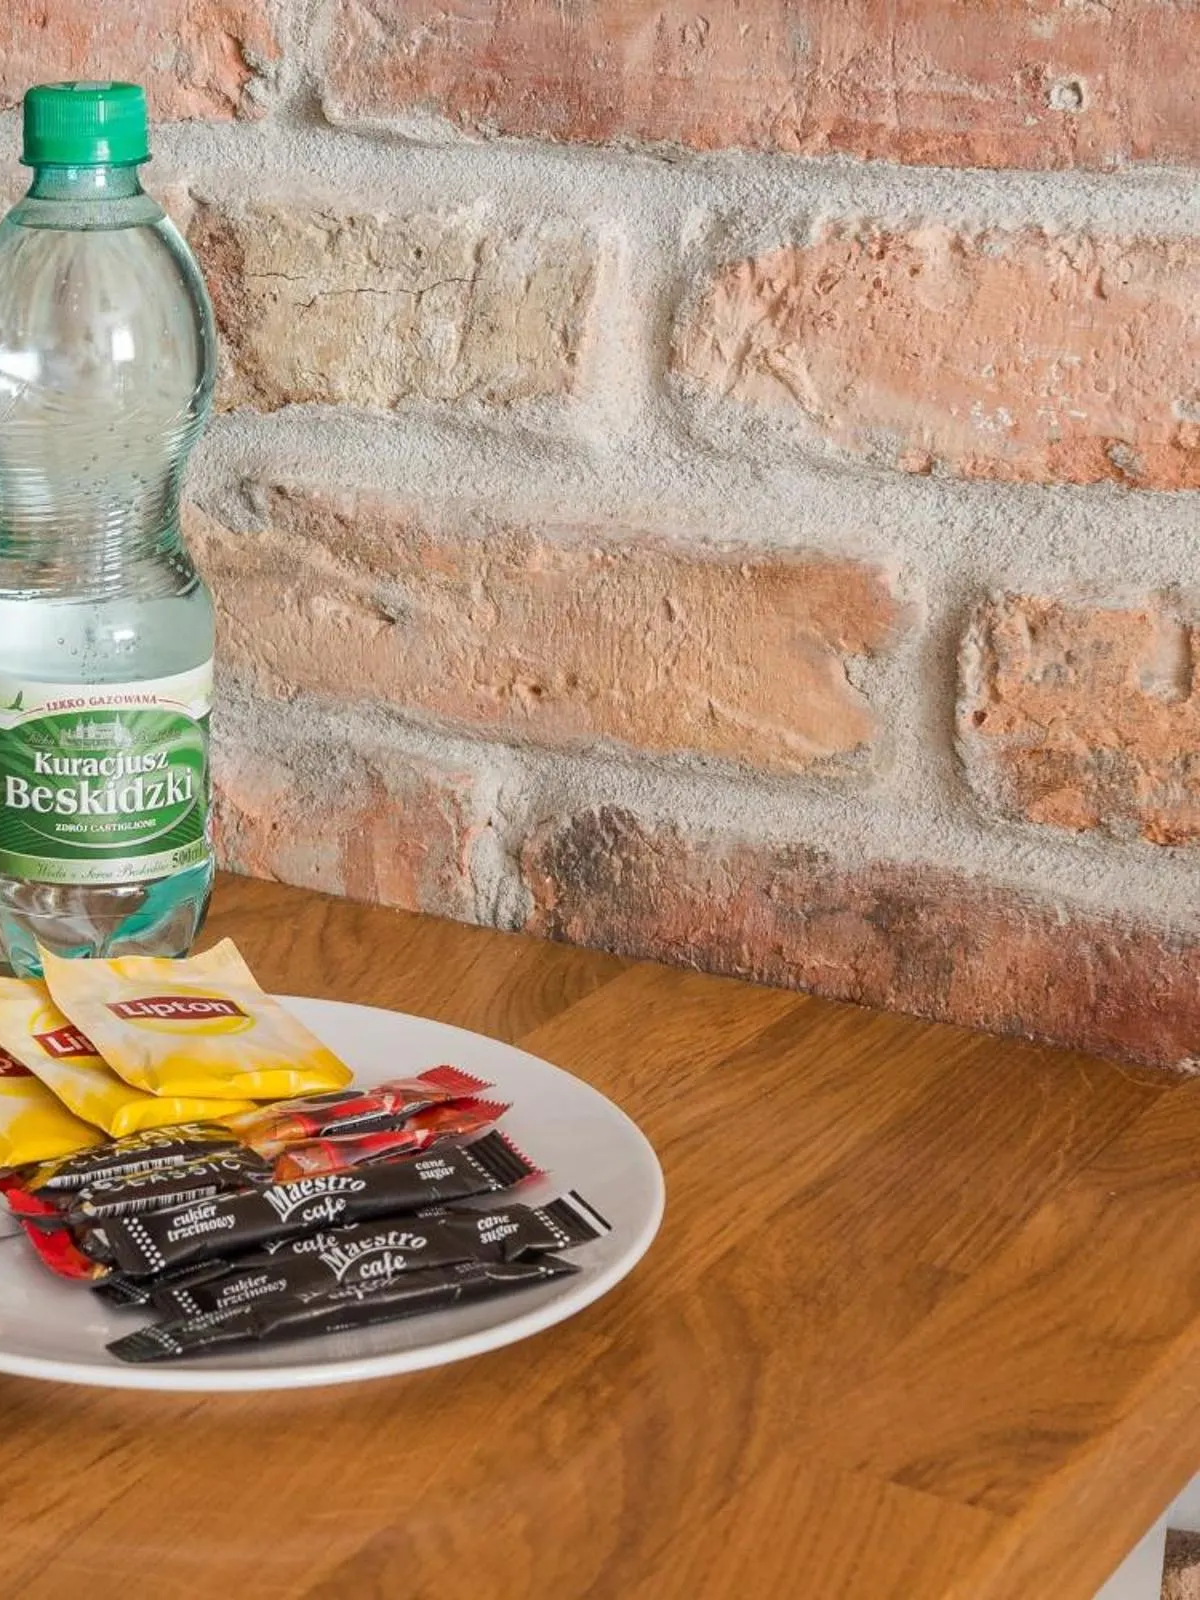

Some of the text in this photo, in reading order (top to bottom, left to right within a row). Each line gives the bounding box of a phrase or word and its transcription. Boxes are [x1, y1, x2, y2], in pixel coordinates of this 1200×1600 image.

[47, 695, 157, 710] LEKKO GAZOWANA
[34, 751, 169, 779] Kuracjusz
[5, 767, 193, 815] Beskidzki
[118, 998, 234, 1017] Lipton
[415, 1160, 446, 1171] cane
[420, 1166, 456, 1180] sugar
[263, 1175, 366, 1223] Maestro
[302, 1196, 346, 1221] cafe
[172, 1202, 217, 1228] cukier
[477, 1215, 510, 1231] cane
[167, 1213, 236, 1243] trzcinowy
[480, 1223, 519, 1244] sugar
[292, 1233, 339, 1254] cafe
[318, 1231, 428, 1282] Maestro
[359, 1252, 407, 1279] cafe
[216, 1278, 288, 1310] trzcinowy
[222, 1274, 268, 1296] cukier
